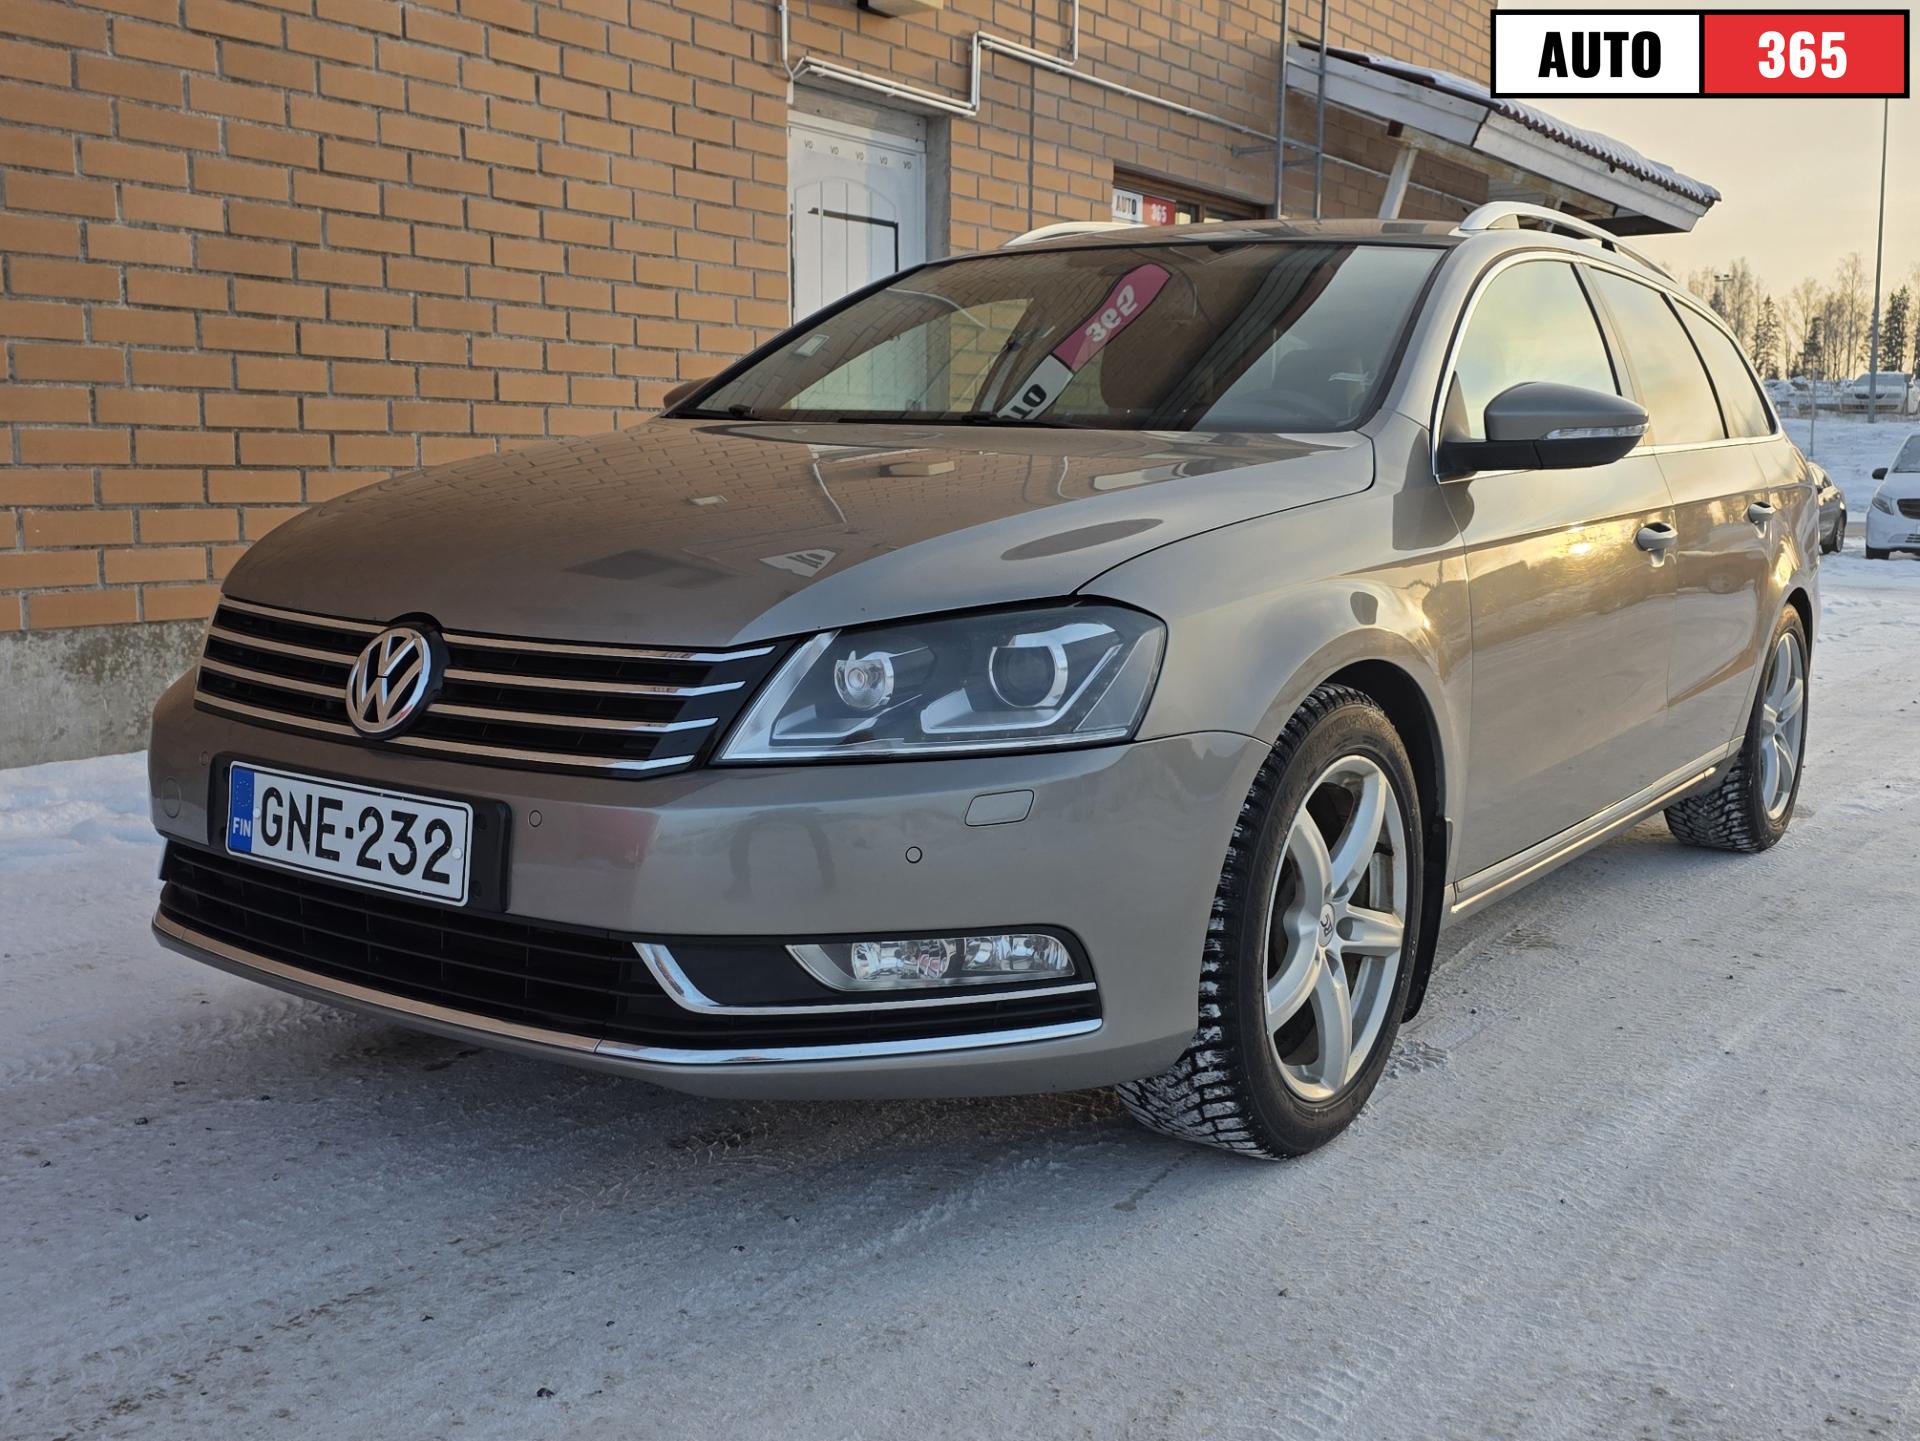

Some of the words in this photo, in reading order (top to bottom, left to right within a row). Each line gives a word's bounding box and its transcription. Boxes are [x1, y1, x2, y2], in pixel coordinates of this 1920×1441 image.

[1115, 195, 1137, 215] AUTO
[1151, 203, 1168, 224] 365
[232, 816, 252, 838] FIN
[260, 786, 453, 885] GNE-232
